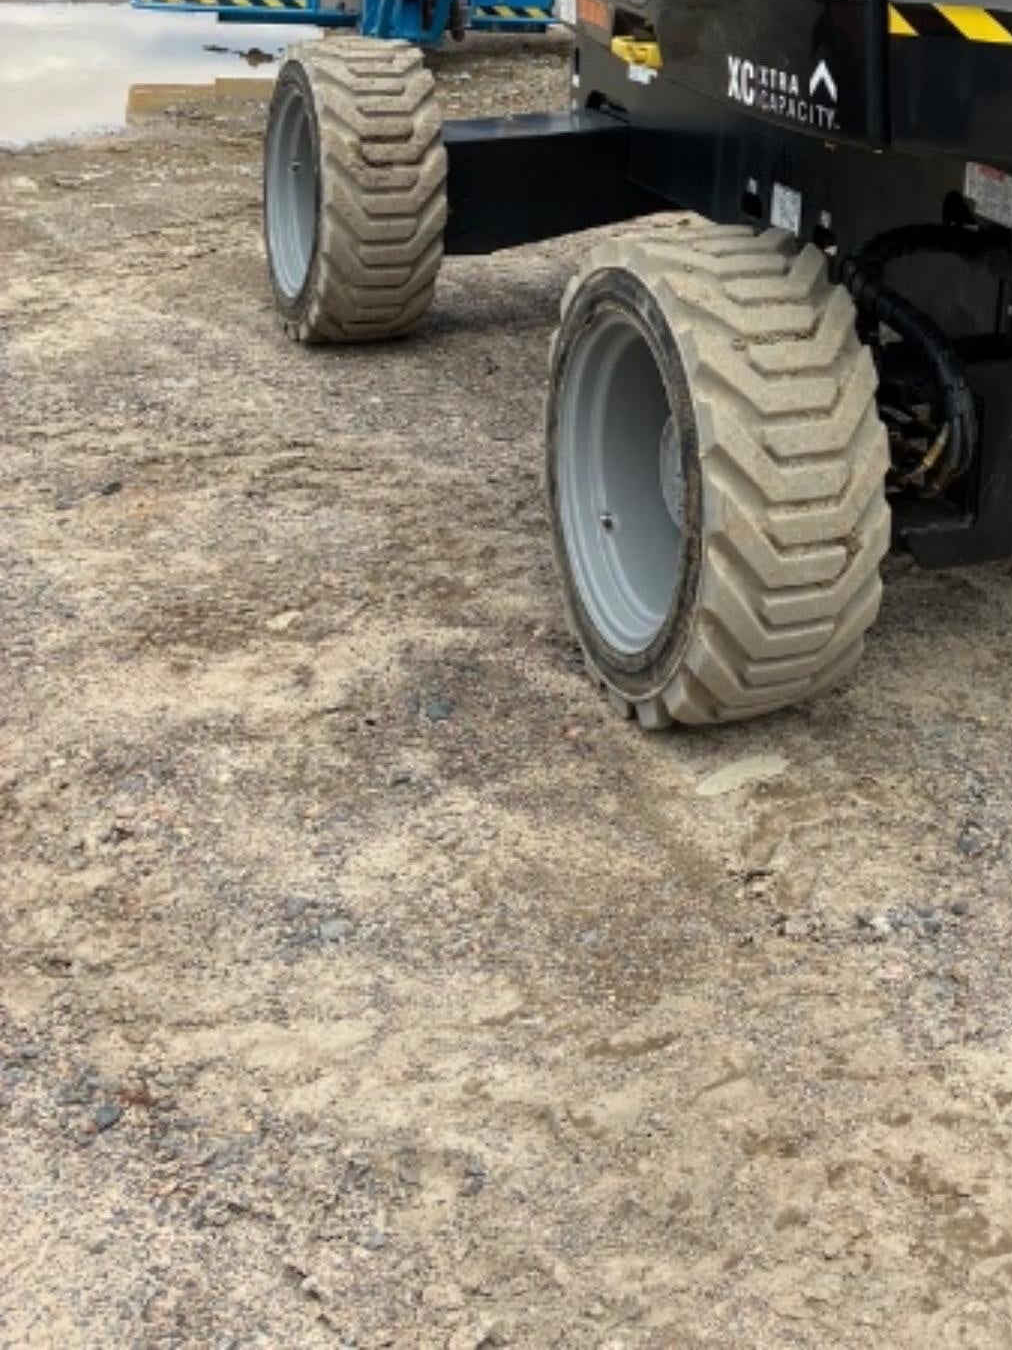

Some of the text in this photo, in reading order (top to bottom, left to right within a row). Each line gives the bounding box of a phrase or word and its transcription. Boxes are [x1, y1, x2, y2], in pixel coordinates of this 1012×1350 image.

[727, 54, 754, 106] XC
[759, 65, 799, 97] XTRA
[760, 89, 836, 130] CAPACITY
